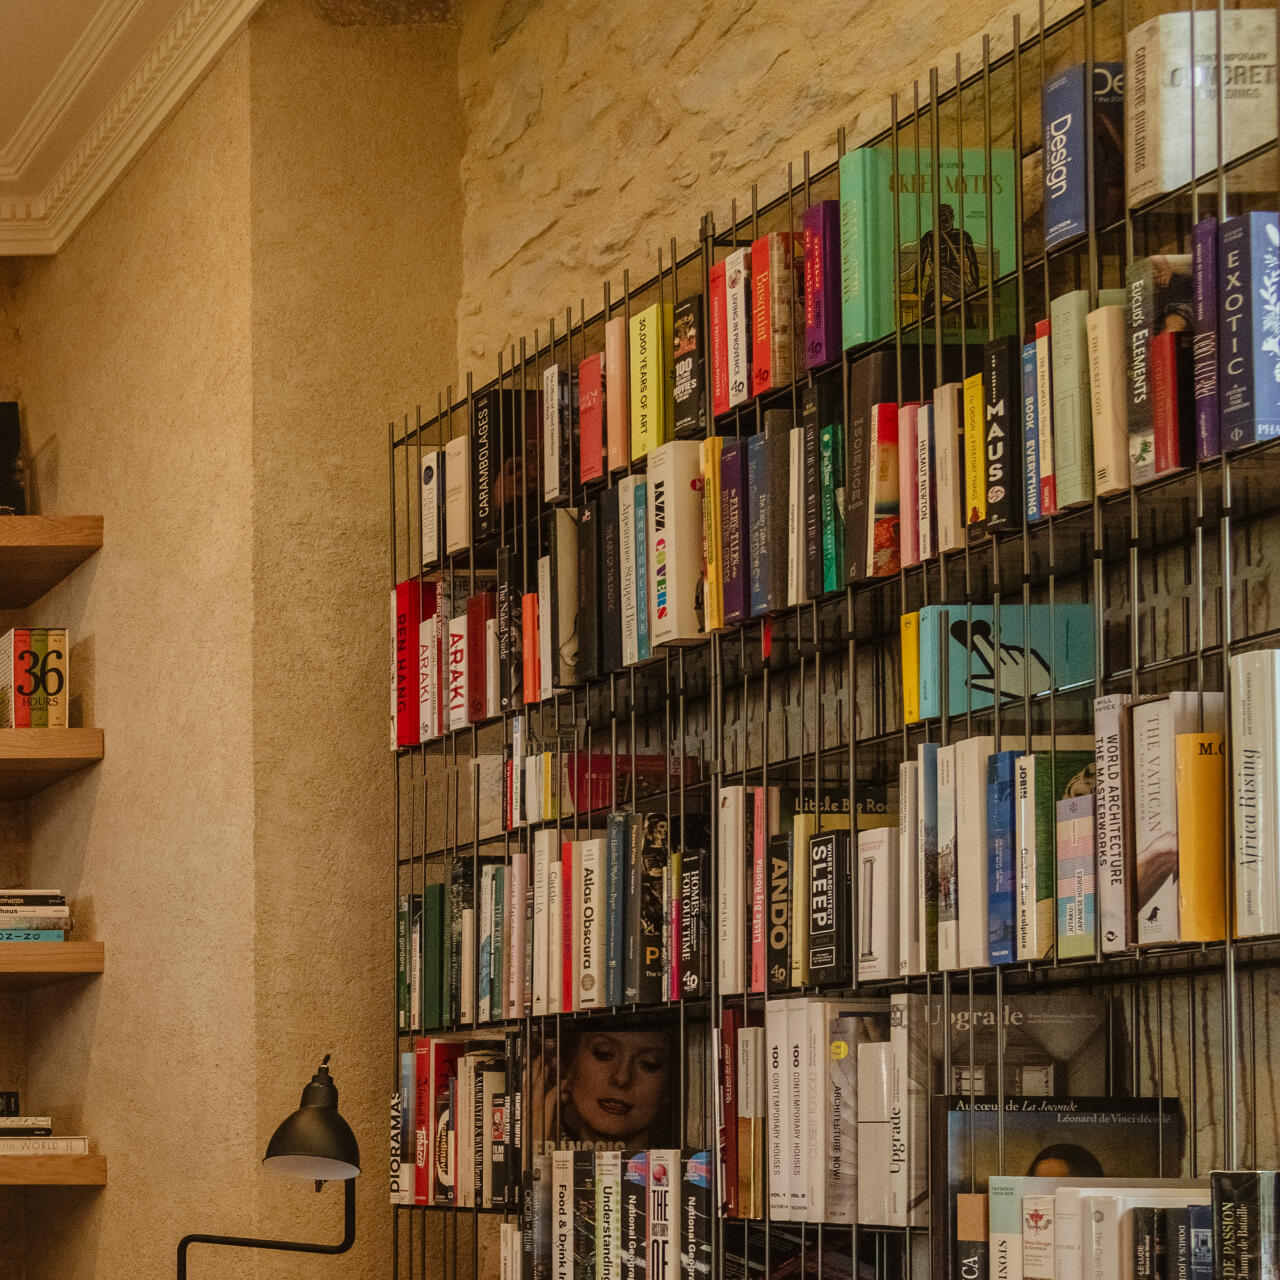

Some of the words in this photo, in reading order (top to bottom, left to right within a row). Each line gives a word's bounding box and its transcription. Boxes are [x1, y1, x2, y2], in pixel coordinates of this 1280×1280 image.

[1046, 113, 1072, 199] Design
[1134, 110, 1147, 174] BUILDINGS
[753, 271, 769, 343] Basquiat
[1224, 250, 1244, 376] EXOTIC
[639, 317, 648, 356] 30,000
[639, 357, 648, 393] YEARS
[1133, 329, 1150, 404] ELEMENTS
[640, 413, 649, 434] ART
[1025, 395, 1035, 432] BOOK
[478, 407, 489, 518] CARAMBOLAGES
[986, 399, 1006, 481] MAUS
[920, 475, 928, 521] NEWTON
[1026, 439, 1037, 515] EVERYTHING
[655, 538, 668, 620] COVERS
[396, 613, 407, 652] REN
[500, 634, 509, 660] Nude
[16, 649, 65, 697] 36
[396, 659, 407, 714] HANG
[419, 644, 430, 704] ARAKI
[449, 633, 465, 711] ARAKI
[21, 696, 59, 708] HOURS
[1095, 736, 1104, 763] THE
[1106, 734, 1119, 780] WORLD
[1146, 713, 1159, 754] THE
[1019, 764, 1027, 799] JOBIN
[1147, 757, 1162, 833] VATICAN
[1241, 747, 1262, 808] Rising
[1096, 766, 1107, 867] MASTERWORKS
[1107, 783, 1123, 886] ARCHITECTURE
[1240, 811, 1258, 873] Africa
[583, 867, 594, 903] Atlas
[683, 872, 691, 895] FOR
[683, 896, 691, 920] OUR
[690, 870, 699, 917] HOMES
[770, 857, 788, 950] ANDO
[812, 845, 828, 927] SLEEP
[826, 874, 834, 924] ARCHITECTS
[583, 905, 594, 970] Obscura
[683, 922, 691, 961] TIME
[752, 906, 763, 943] Little
[792, 1043, 800, 1068] 100
[773, 1072, 781, 1140] CONTEMPORARY
[793, 1071, 801, 1140] CONTEMPORARY
[833, 1086, 841, 1153] ARCHITECTURE
[1038, 1100, 1078, 1112] Joconde
[1057, 1113, 1096, 1123] Léonard
[1111, 1113, 1136, 1123] Vinci
[21, 1142, 59, 1150] WORLD
[390, 1092, 401, 1193] DIORAMAS
[890, 1106, 905, 1174] Upgrade
[558, 1184, 567, 1217] Food
[652, 1190, 669, 1222] THE
[559, 1233, 567, 1270] Drink
[1222, 1202, 1235, 1255] PASSION
[1222, 1259, 1236, 1279] DE
